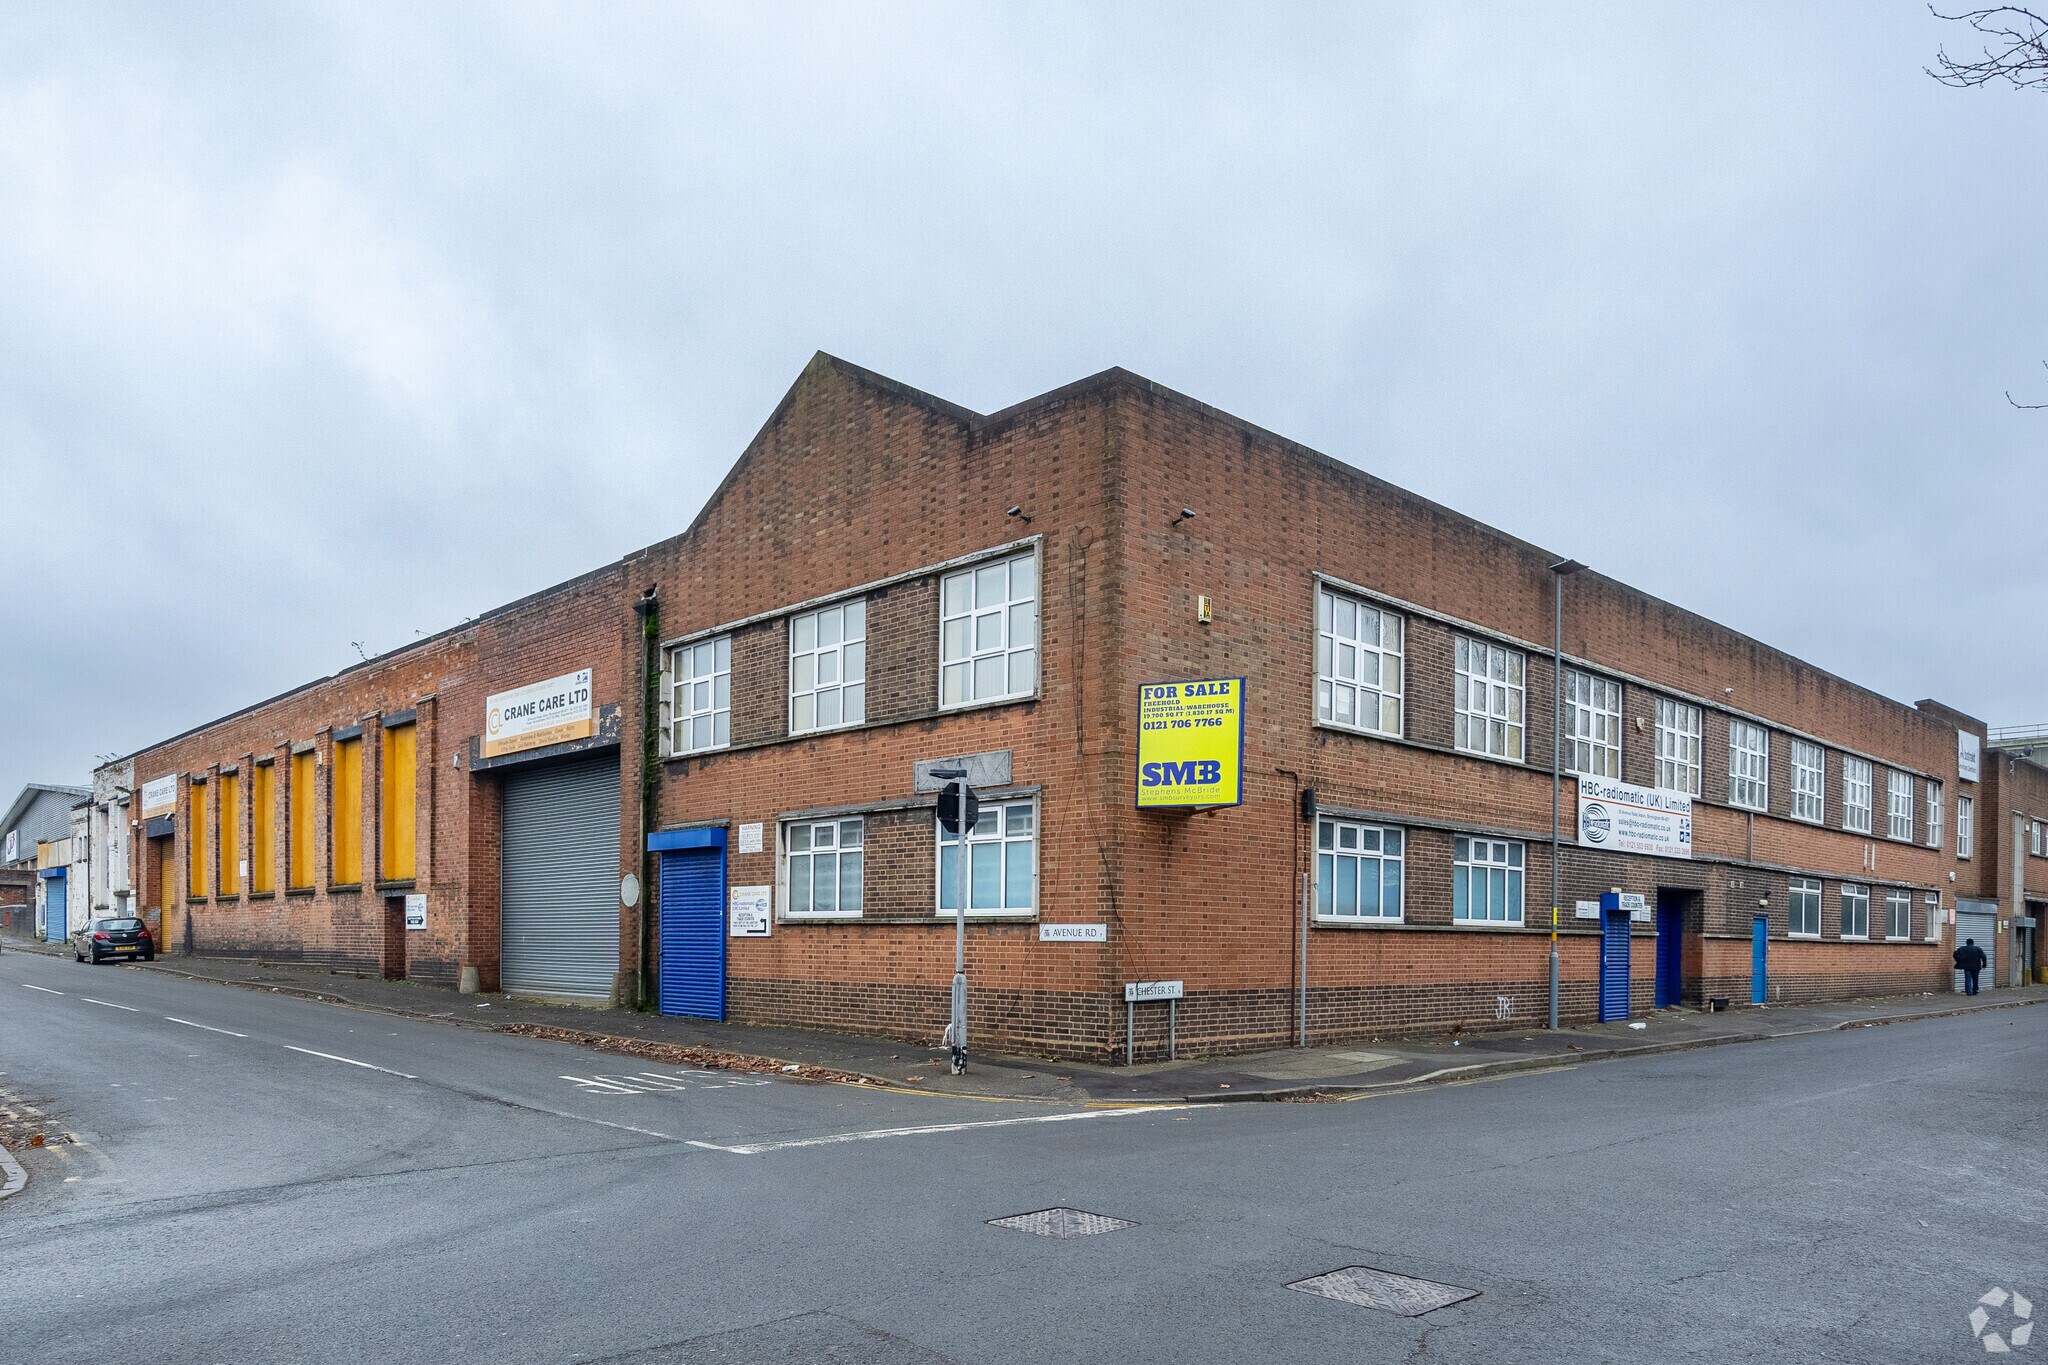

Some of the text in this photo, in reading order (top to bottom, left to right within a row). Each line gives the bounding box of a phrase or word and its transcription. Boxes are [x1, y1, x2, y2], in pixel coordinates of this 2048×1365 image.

[1144, 682, 1229, 699] FOR SALE
[504, 702, 535, 720] CRANE
[539, 694, 565, 712] CARE
[569, 688, 588, 705] LTD
[1144, 703, 1229, 713] INDUSTRIAL/WAREHOUSE
[1143, 718, 1222, 730] 0121 706 7766
[1142, 760, 1221, 786] SMB
[1581, 780, 1690, 812] HBC-radiomatic (UK) Limited
[1085, 929, 1097, 937] RD
[1137, 986, 1166, 995] CHESTER
